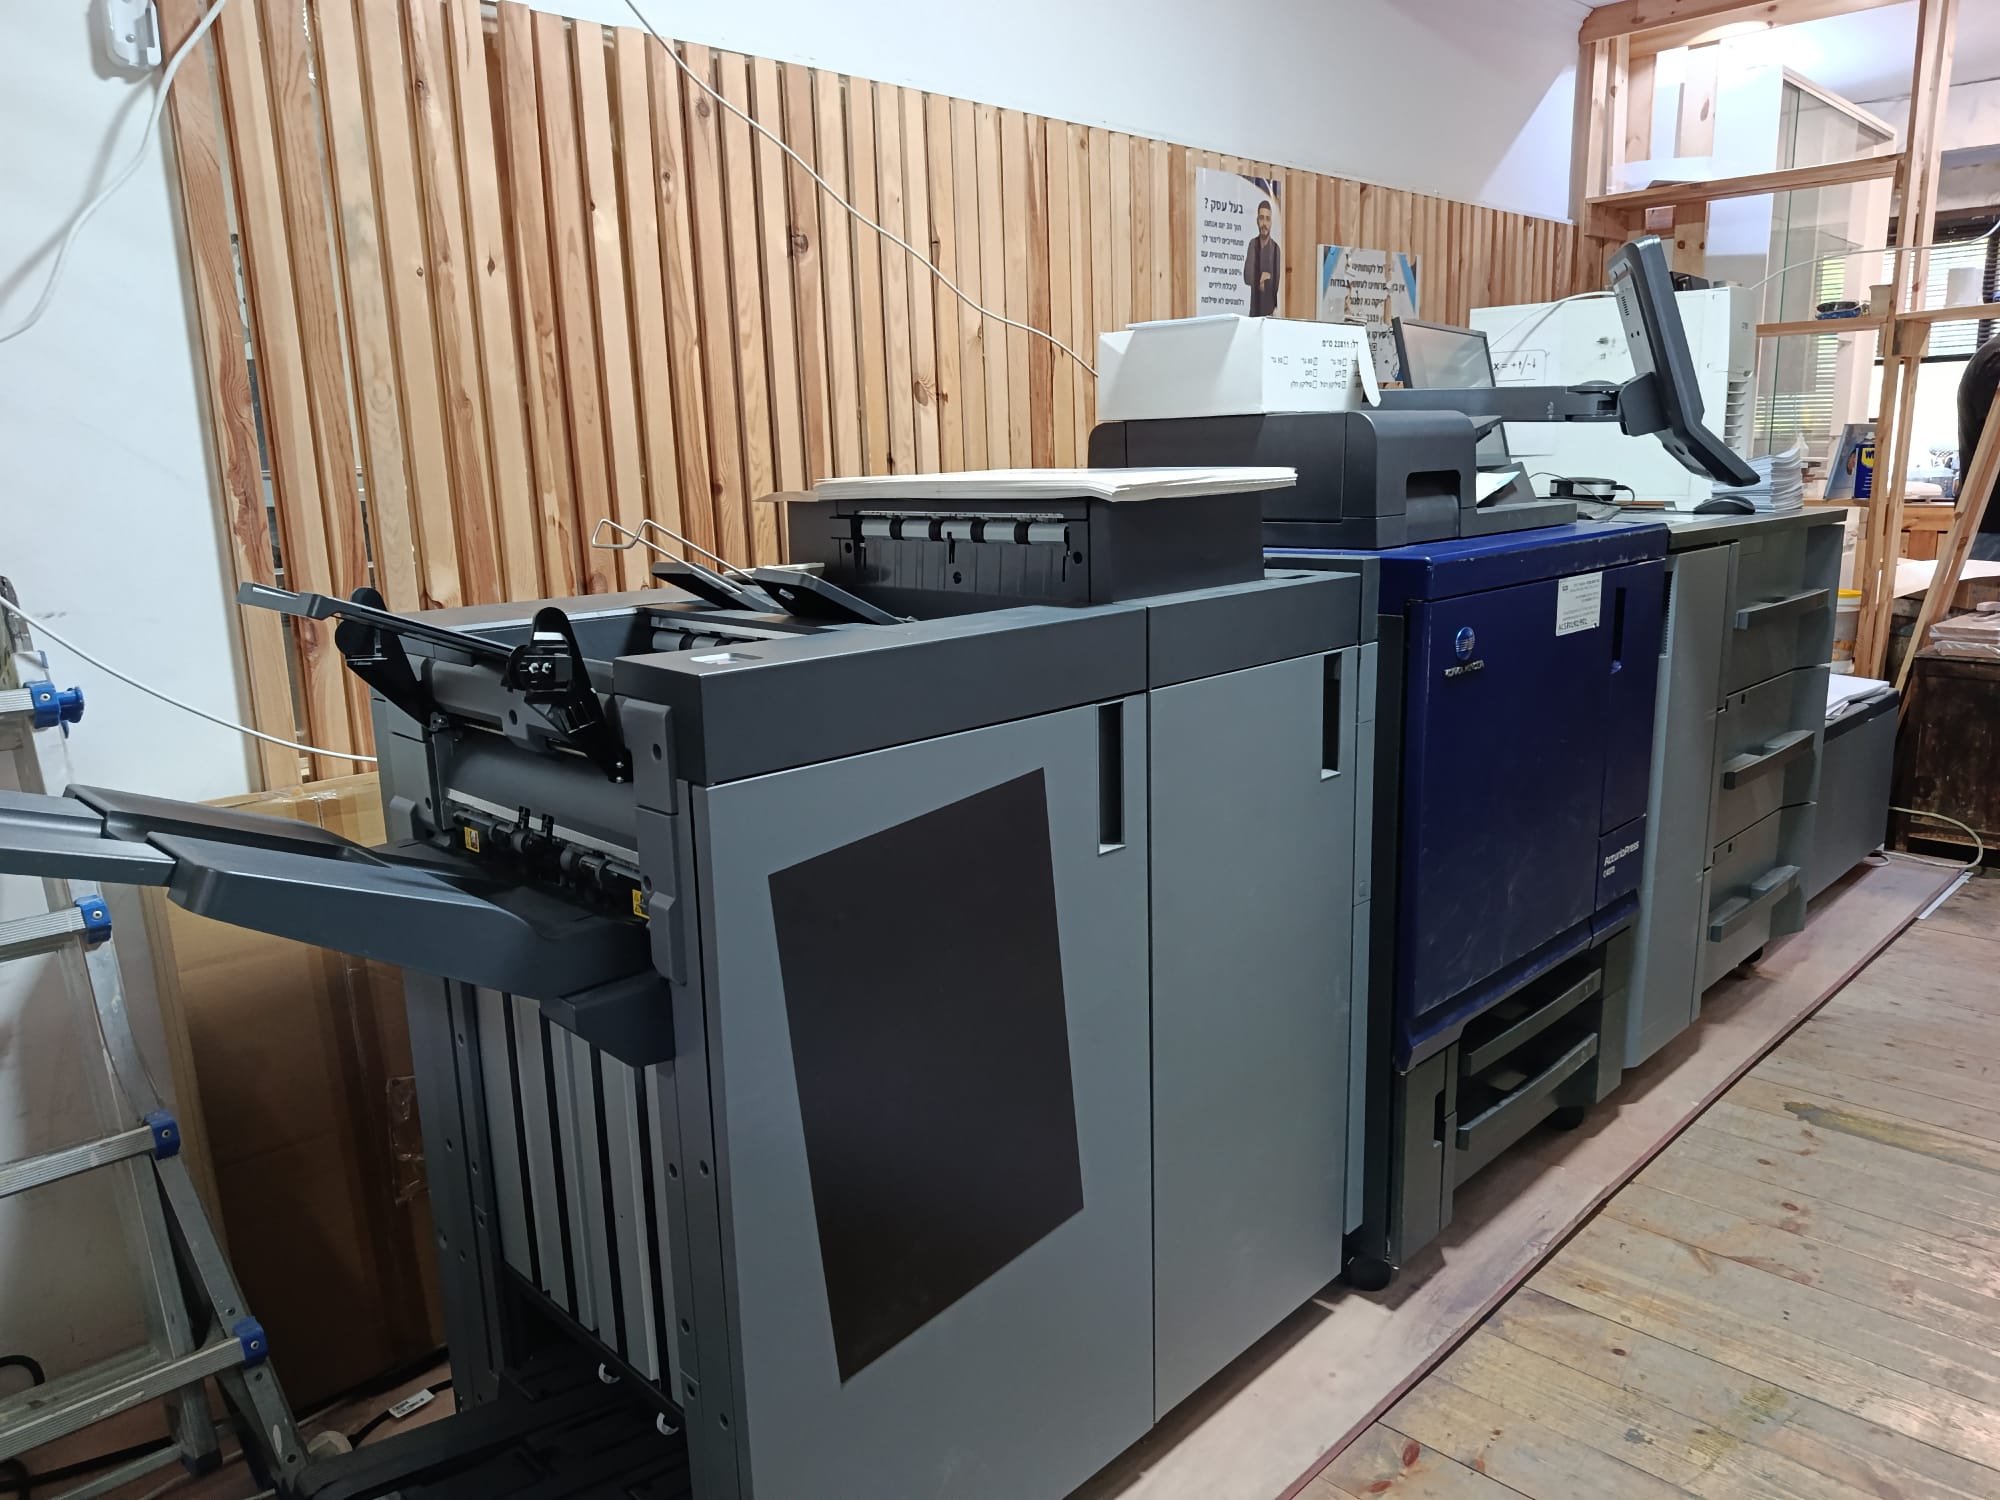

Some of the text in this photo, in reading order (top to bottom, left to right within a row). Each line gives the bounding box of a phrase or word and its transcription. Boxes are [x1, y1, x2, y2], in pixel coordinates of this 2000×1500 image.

[1204, 197, 1244, 214] בעל עסק ?
[1202, 234, 1208, 244] לך
[1203, 265, 1210, 273] לא
[1218, 296, 1225, 304] לא
